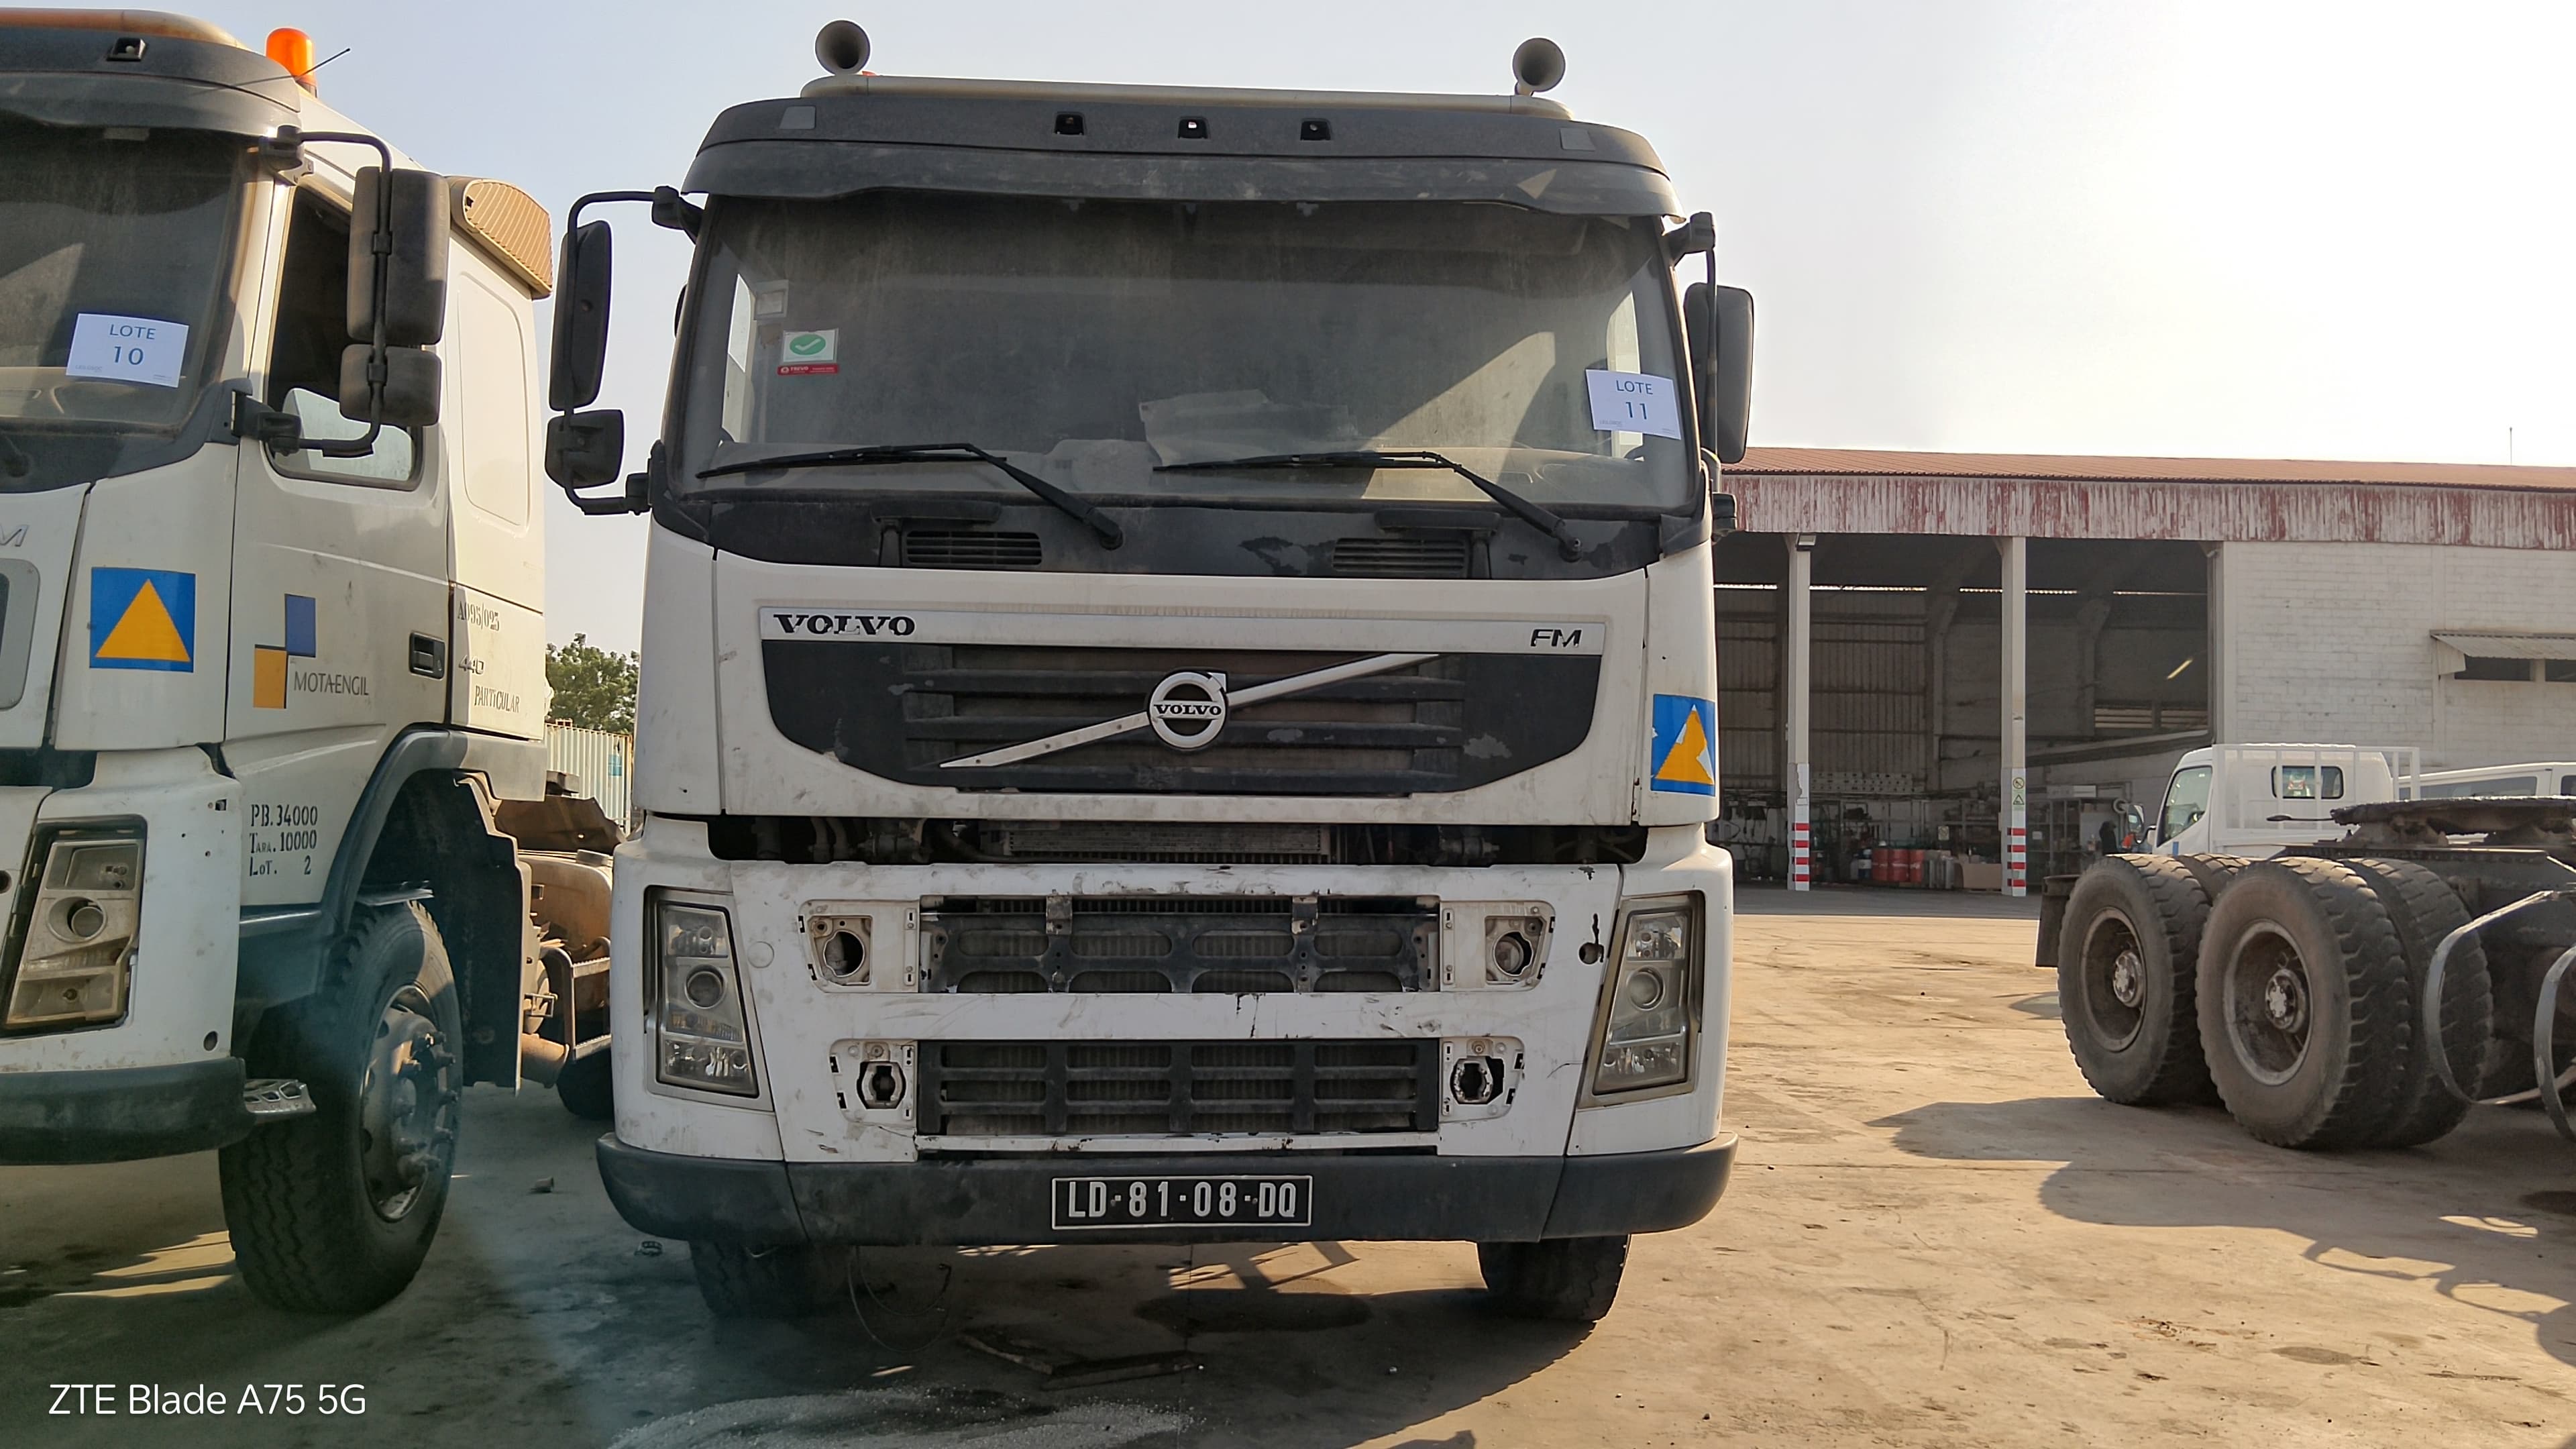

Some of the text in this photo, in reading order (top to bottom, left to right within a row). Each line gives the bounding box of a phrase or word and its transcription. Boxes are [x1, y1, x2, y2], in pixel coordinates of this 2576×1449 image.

[109, 324, 156, 339] LOTE
[114, 345, 144, 365] 10
[1616, 380, 1653, 394] LOTE
[1626, 402, 1647, 420] 11
[773, 614, 915, 636] VOLVO
[1531, 629, 1582, 647] FM
[1154, 704, 1222, 716] VOLVO
[304, 855, 311, 875] 2
